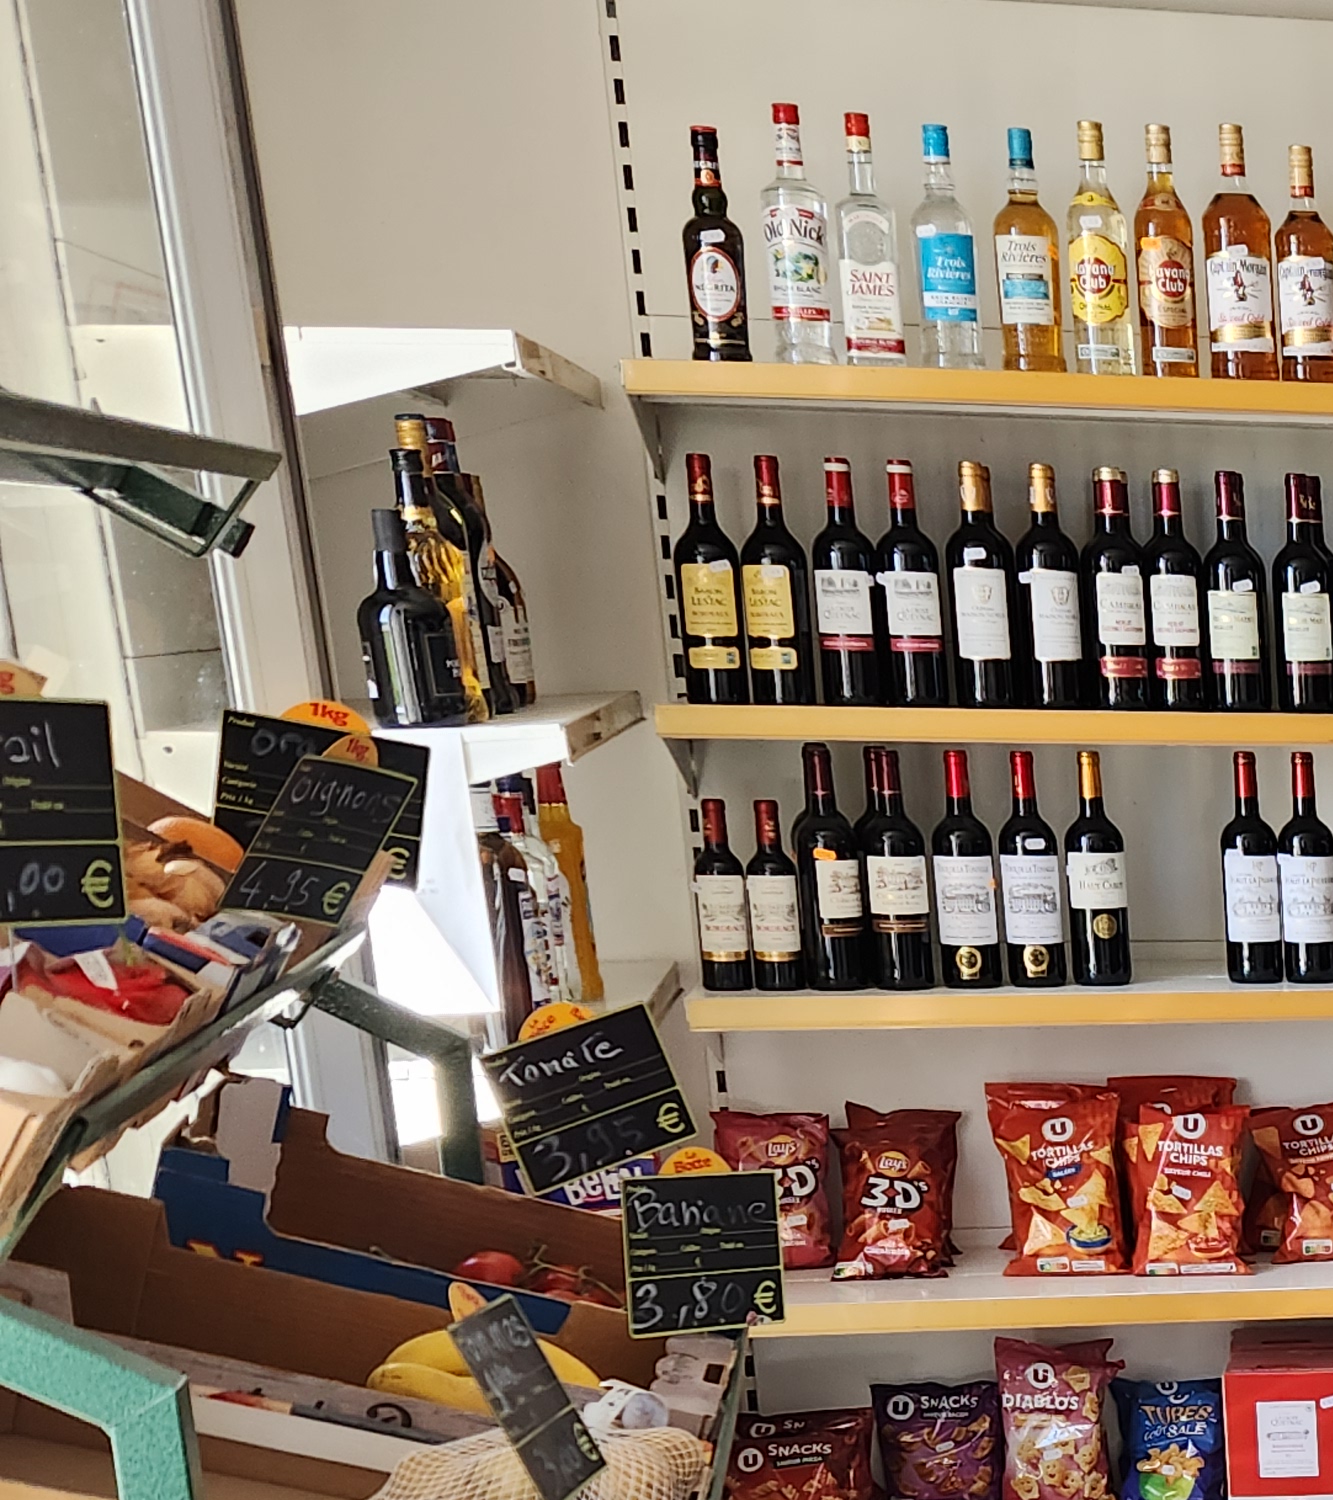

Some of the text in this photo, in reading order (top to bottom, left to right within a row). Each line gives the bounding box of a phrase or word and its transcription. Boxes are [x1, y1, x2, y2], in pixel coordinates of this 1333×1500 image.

[790, 217, 824, 247] Nick
[1007, 239, 1038, 252] Trois
[935, 255, 968, 270] Trois
[1000, 251, 1048, 265] Rivières
[850, 268, 892, 284] SAINT
[1079, 275, 1107, 289] Club
[847, 283, 895, 298] JAMES
[1157, 278, 1185, 293] Club
[309, 702, 350, 728] 1kg
[346, 737, 370, 762] 1kg
[81, 859, 114, 908] €
[322, 881, 351, 915] €
[499, 1030, 624, 1088] Tomate
[656, 1102, 686, 1134] €
[767, 1141, 797, 1158] Lay's
[1031, 1142, 1095, 1162] TORTILLAS
[1157, 1140, 1224, 1157] TORTILLAS
[878, 1156, 908, 1171] Lay's
[1169, 1152, 1208, 1167] CHIPS
[626, 1187, 767, 1233] Banane
[753, 1280, 777, 1314] €
[920, 1393, 979, 1410] SNACKS
[1002, 1391, 1080, 1412] DIABLOS
[1141, 1403, 1213, 1427] TUBES
[767, 1441, 833, 1458] SNACKS
